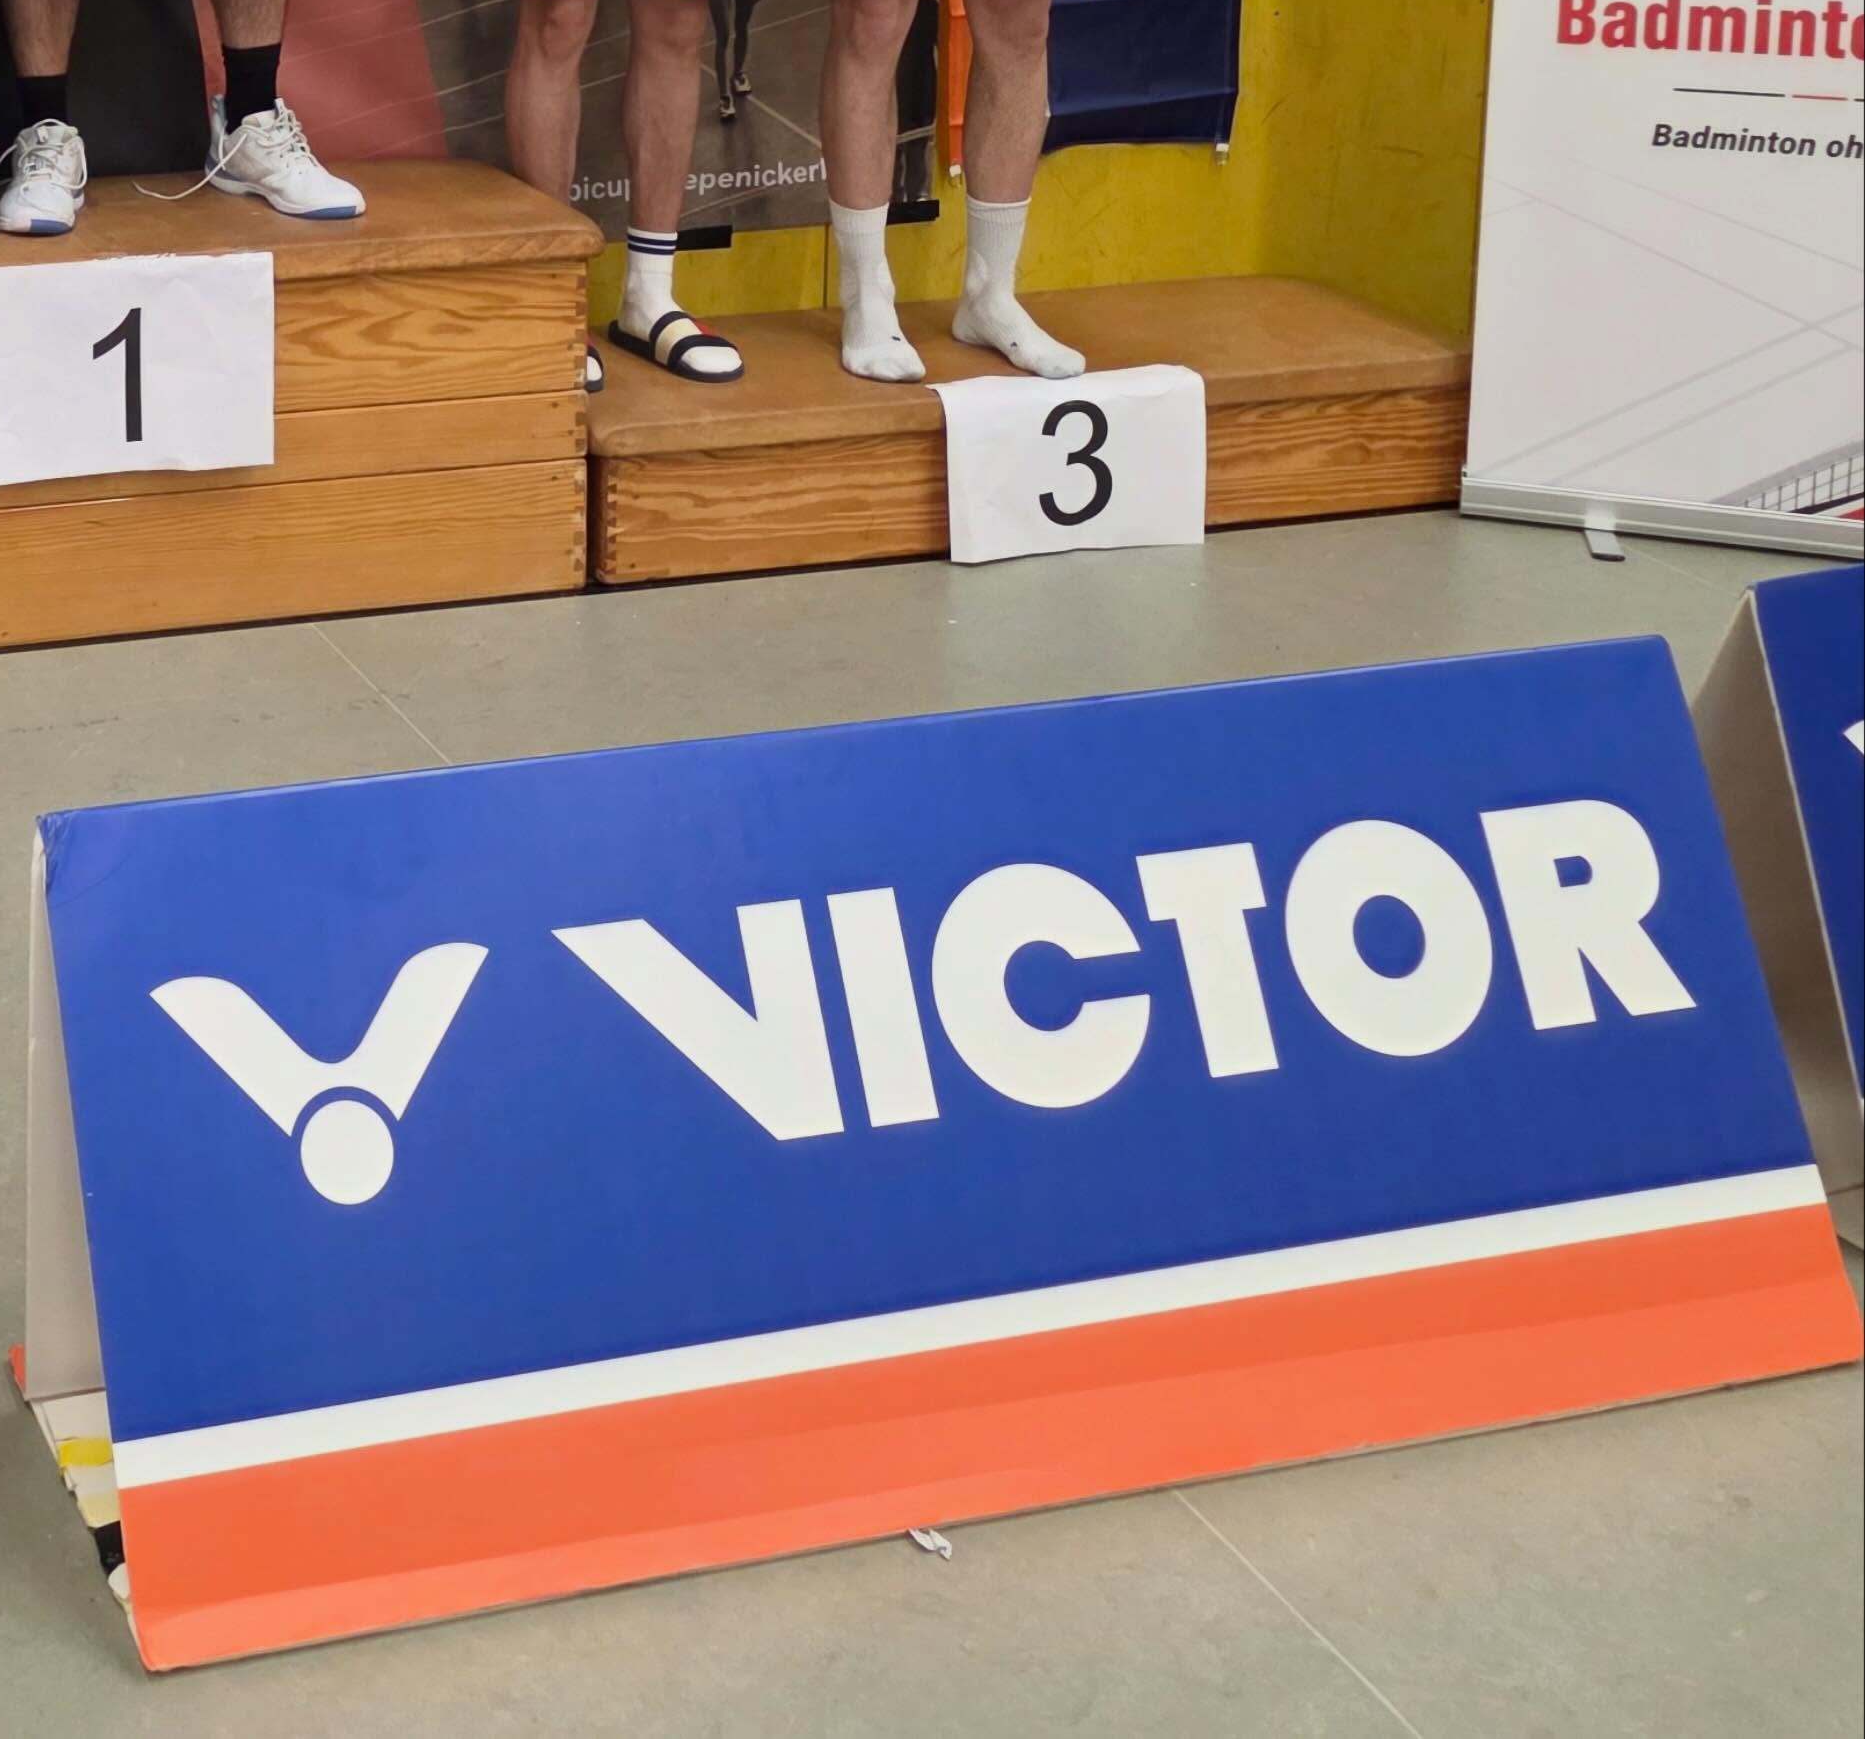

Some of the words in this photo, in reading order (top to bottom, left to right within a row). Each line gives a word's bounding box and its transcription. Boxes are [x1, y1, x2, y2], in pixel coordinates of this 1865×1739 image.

[1651, 123, 1816, 156] Badminton
[92, 307, 143, 442] 1
[1039, 400, 1113, 526] 3
[554, 799, 1698, 1142] VICTOR
